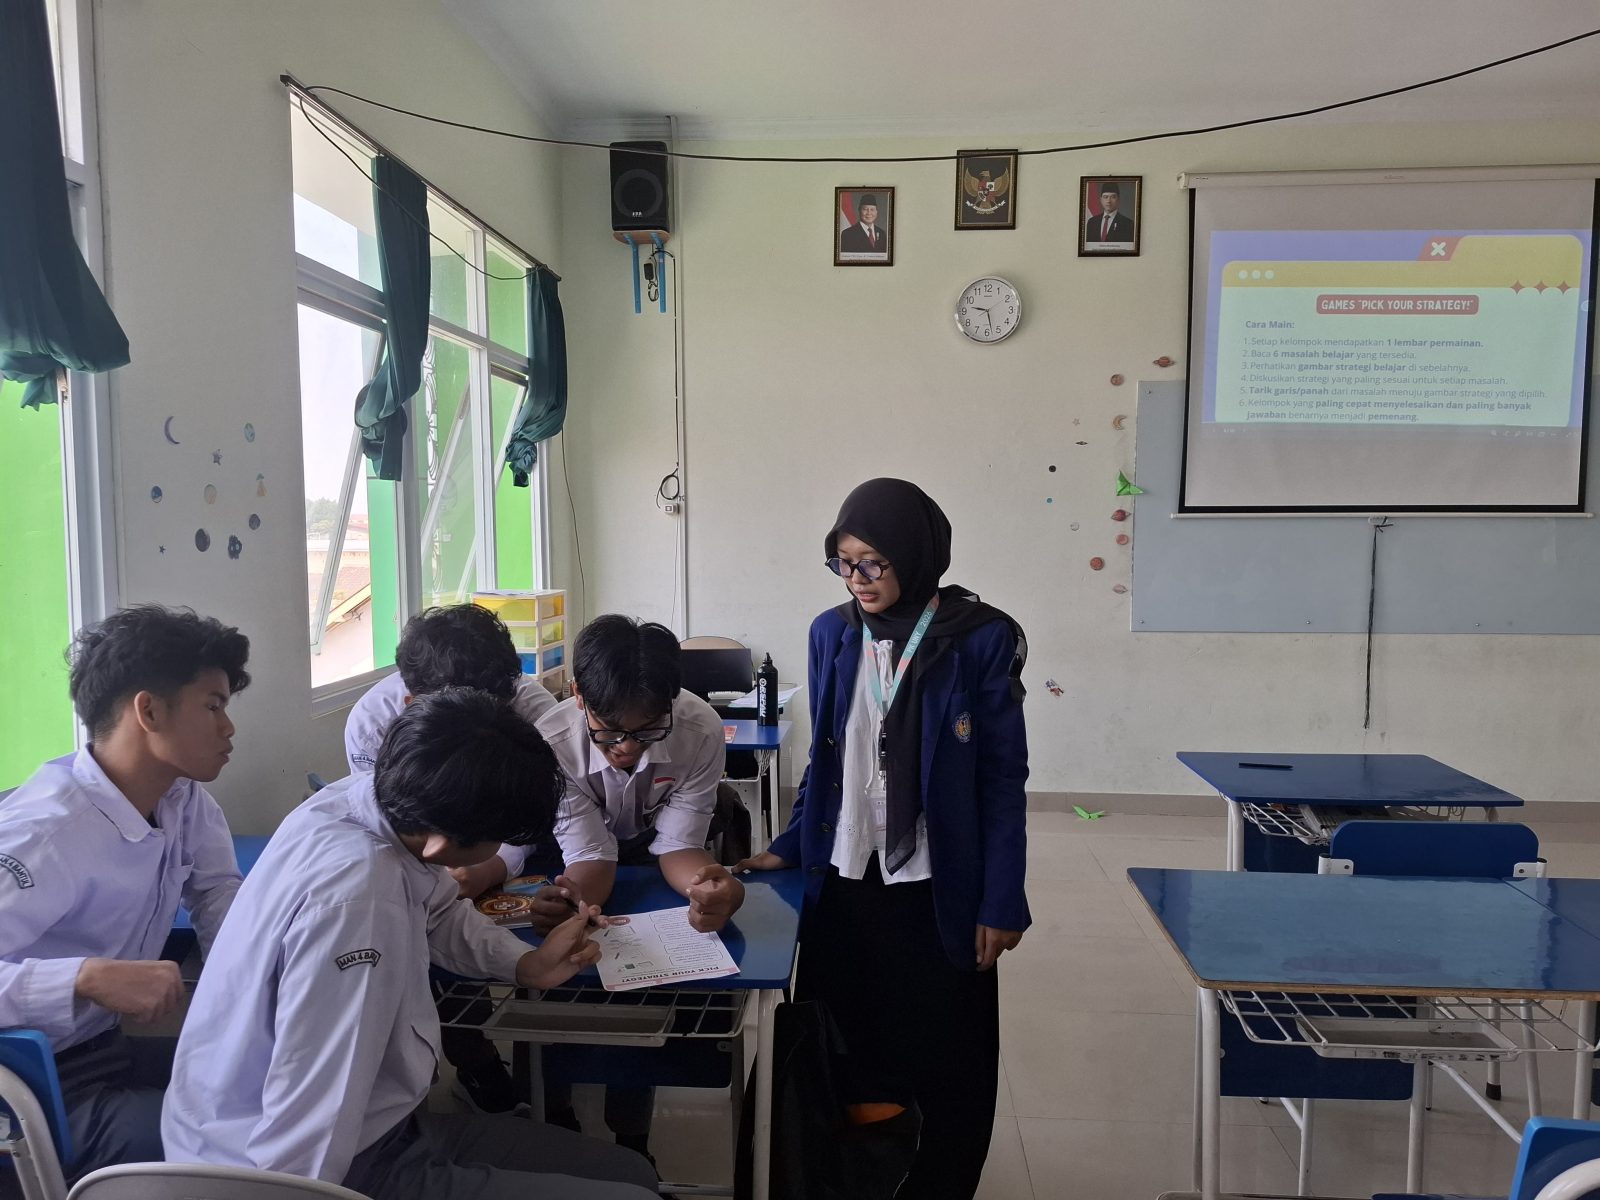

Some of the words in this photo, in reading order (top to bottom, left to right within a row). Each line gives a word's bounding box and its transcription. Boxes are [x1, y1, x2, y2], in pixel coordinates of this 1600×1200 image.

[974, 288, 981, 296] 11
[984, 284, 993, 292] 12
[966, 296, 974, 304] 10
[1004, 294, 1010, 302] 2
[1008, 306, 1014, 314] 3
[1322, 300, 1355, 310] GAMES
[1388, 300, 1413, 310] YOUR
[962, 307, 967, 315] 9
[975, 326, 979, 334] 7
[1246, 321, 1266, 329] Cara
[1269, 321, 1295, 329] Main:
[1251, 337, 1278, 347] Setiap
[1280, 337, 1322, 347] kelompok
[1324, 338, 1384, 348] mendapatkan
[1394, 339, 1427, 347] lembar
[1430, 339, 1484, 349] permainan.
[1281, 350, 1319, 358] masalah
[1322, 350, 1354, 360] belajar
[1356, 352, 1377, 360] yang
[1379, 351, 1417, 359] tersedia.
[1250, 362, 1296, 370] Perhatikan
[1298, 363, 1334, 372] gambar
[1336, 363, 1371, 372] strategi
[1374, 364, 1406, 373] belajar
[1408, 364, 1416, 372] di
[1419, 364, 1471, 374] sebelahnya.
[1250, 374, 1295, 382] Diskusikan
[1297, 376, 1329, 385] strategi
[1332, 377, 1352, 385] yang
[1355, 376, 1380, 385] paling
[1383, 376, 1410, 384] sesuai
[1413, 376, 1438, 384] untuk
[1440, 377, 1466, 386] setiap
[1468, 377, 1508, 385] masalah.
[1274, 387, 1329, 396] garis/panah
[1350, 388, 1386, 396] masalah
[1389, 390, 1422, 398] menuju
[1424, 389, 1458, 398] gambar
[1460, 389, 1493, 398] strategi
[1248, 399, 1290, 408] Kelompok
[1293, 401, 1314, 409] yang
[1315, 400, 1343, 409] paling
[1346, 401, 1372, 409] cepat
[1374, 401, 1444, 410] menyelesaikan
[1446, 401, 1463, 409] dan
[1466, 401, 1495, 411] paling
[1497, 402, 1531, 411] banyak
[1247, 411, 1286, 420] jawaban
[1288, 412, 1328, 420] benarnya
[1331, 412, 1366, 421] menjadi
[1368, 413, 1419, 422] pemenang.
[340, 954, 356, 967] MAN
